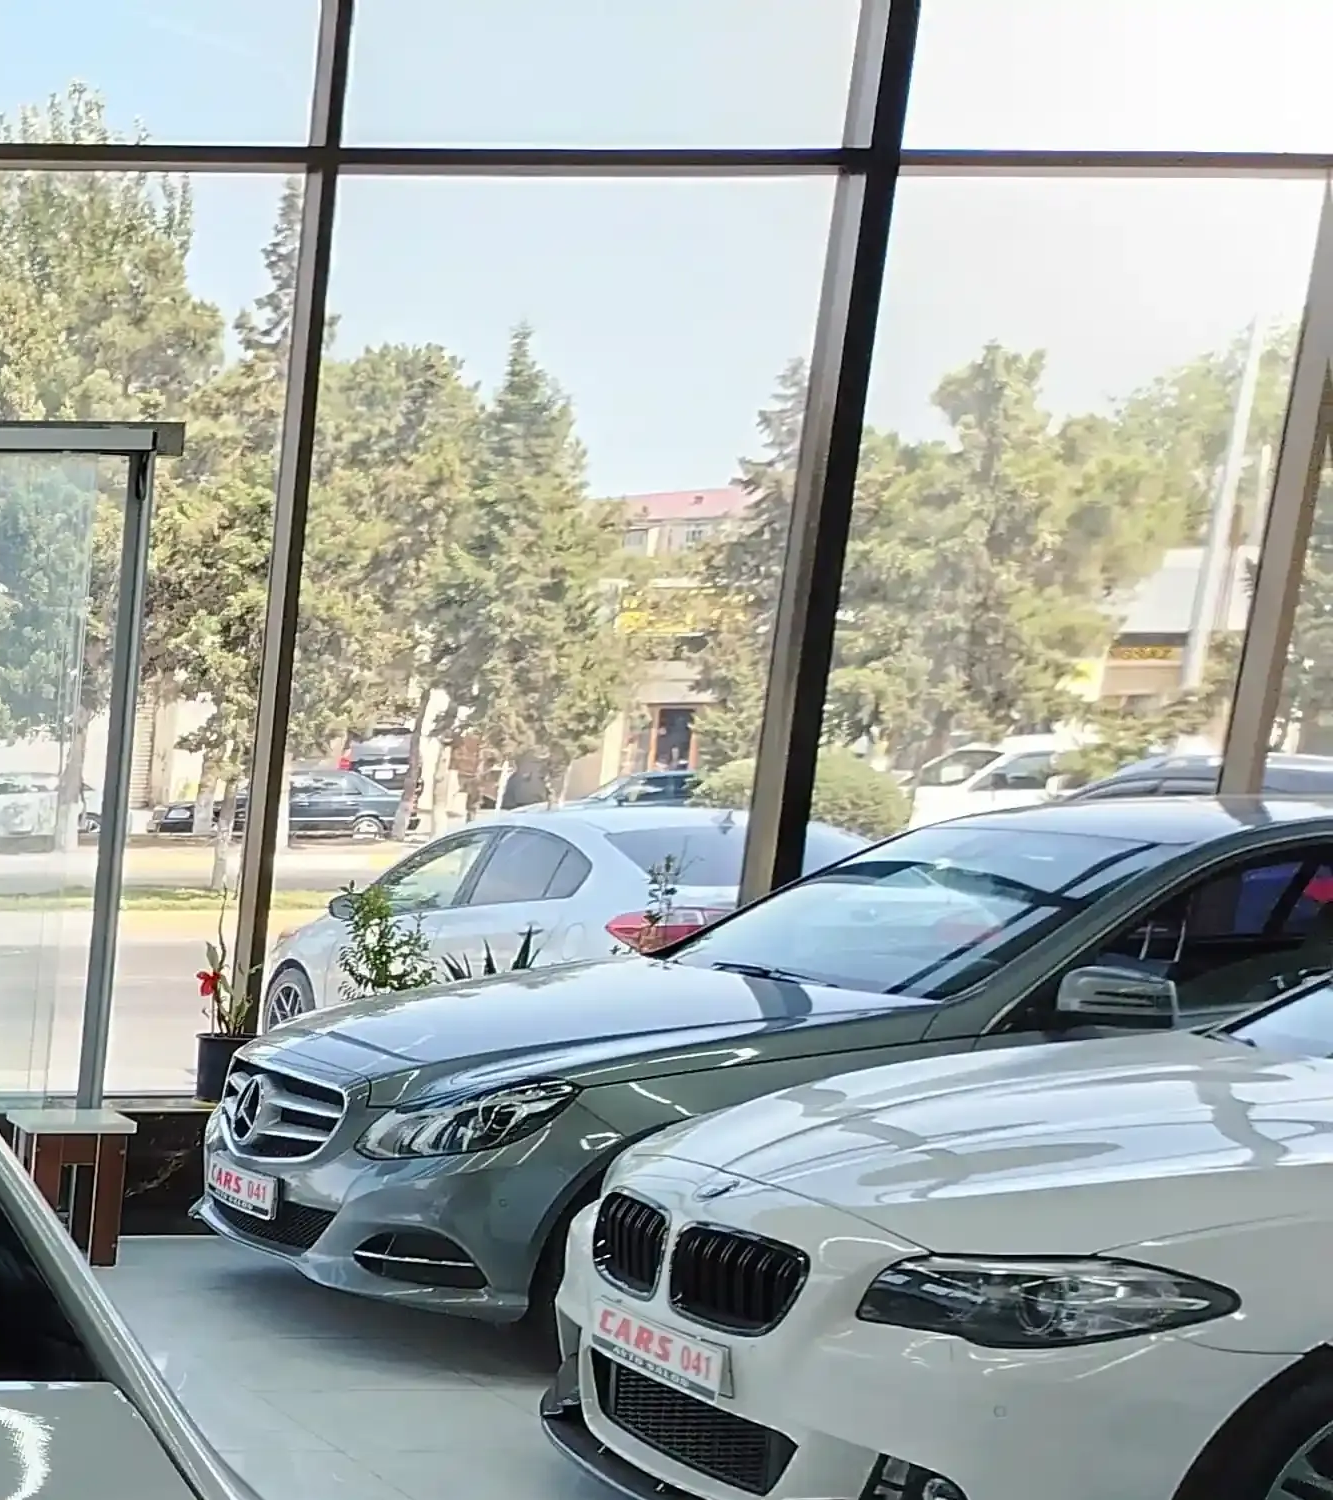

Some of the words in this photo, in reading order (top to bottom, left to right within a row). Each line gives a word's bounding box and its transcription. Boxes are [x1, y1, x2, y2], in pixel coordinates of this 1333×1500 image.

[211, 1163, 243, 1194] CARS
[247, 1180, 266, 1204] 041
[599, 1308, 674, 1363] CARS
[680, 1345, 713, 1381] 041
